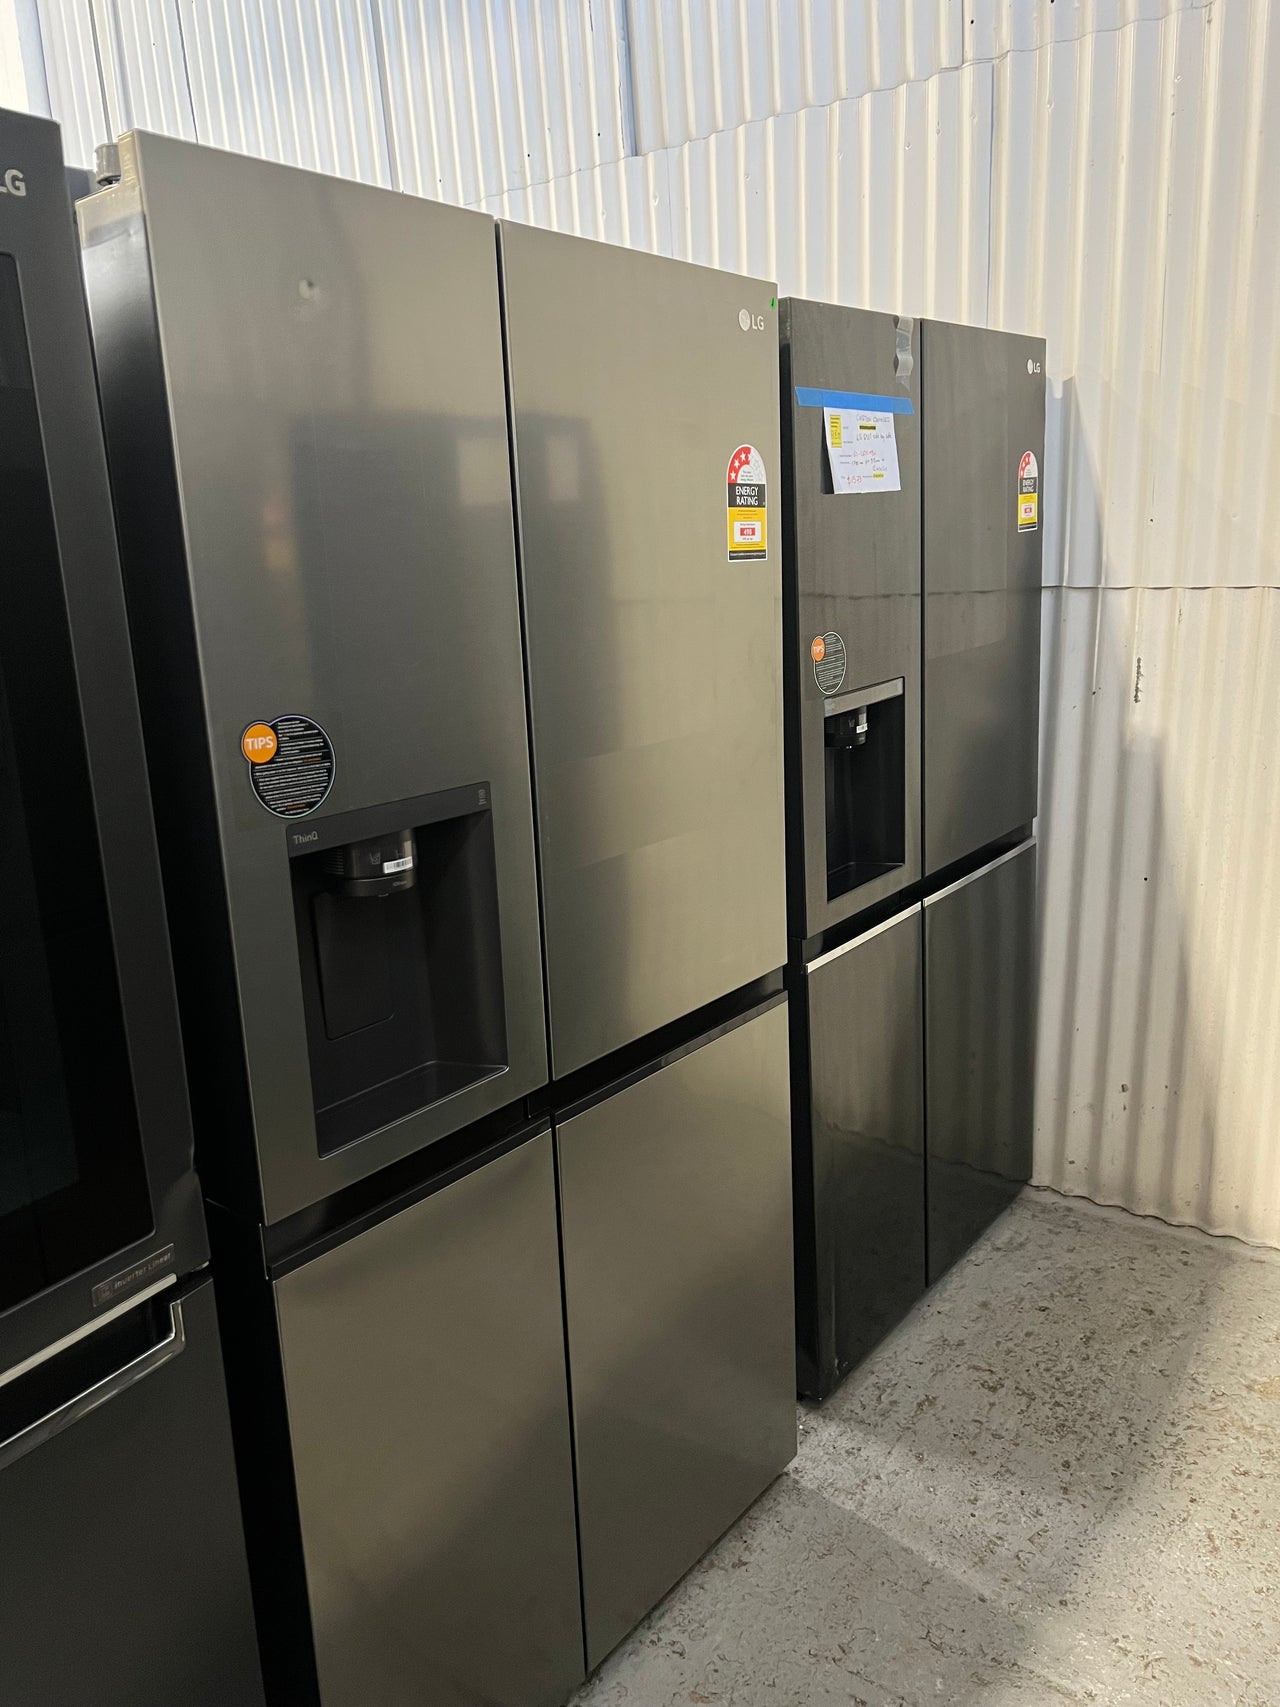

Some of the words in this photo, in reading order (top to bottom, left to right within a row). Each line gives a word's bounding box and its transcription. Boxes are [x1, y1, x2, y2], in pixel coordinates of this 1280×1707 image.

[751, 314, 765, 331] LG
[1033, 362, 1041, 374] LG
[735, 485, 759, 496] ENERGY
[736, 495, 759, 506] RATING
[245, 735, 274, 752] TIPS
[293, 830, 319, 845] ThinQ
